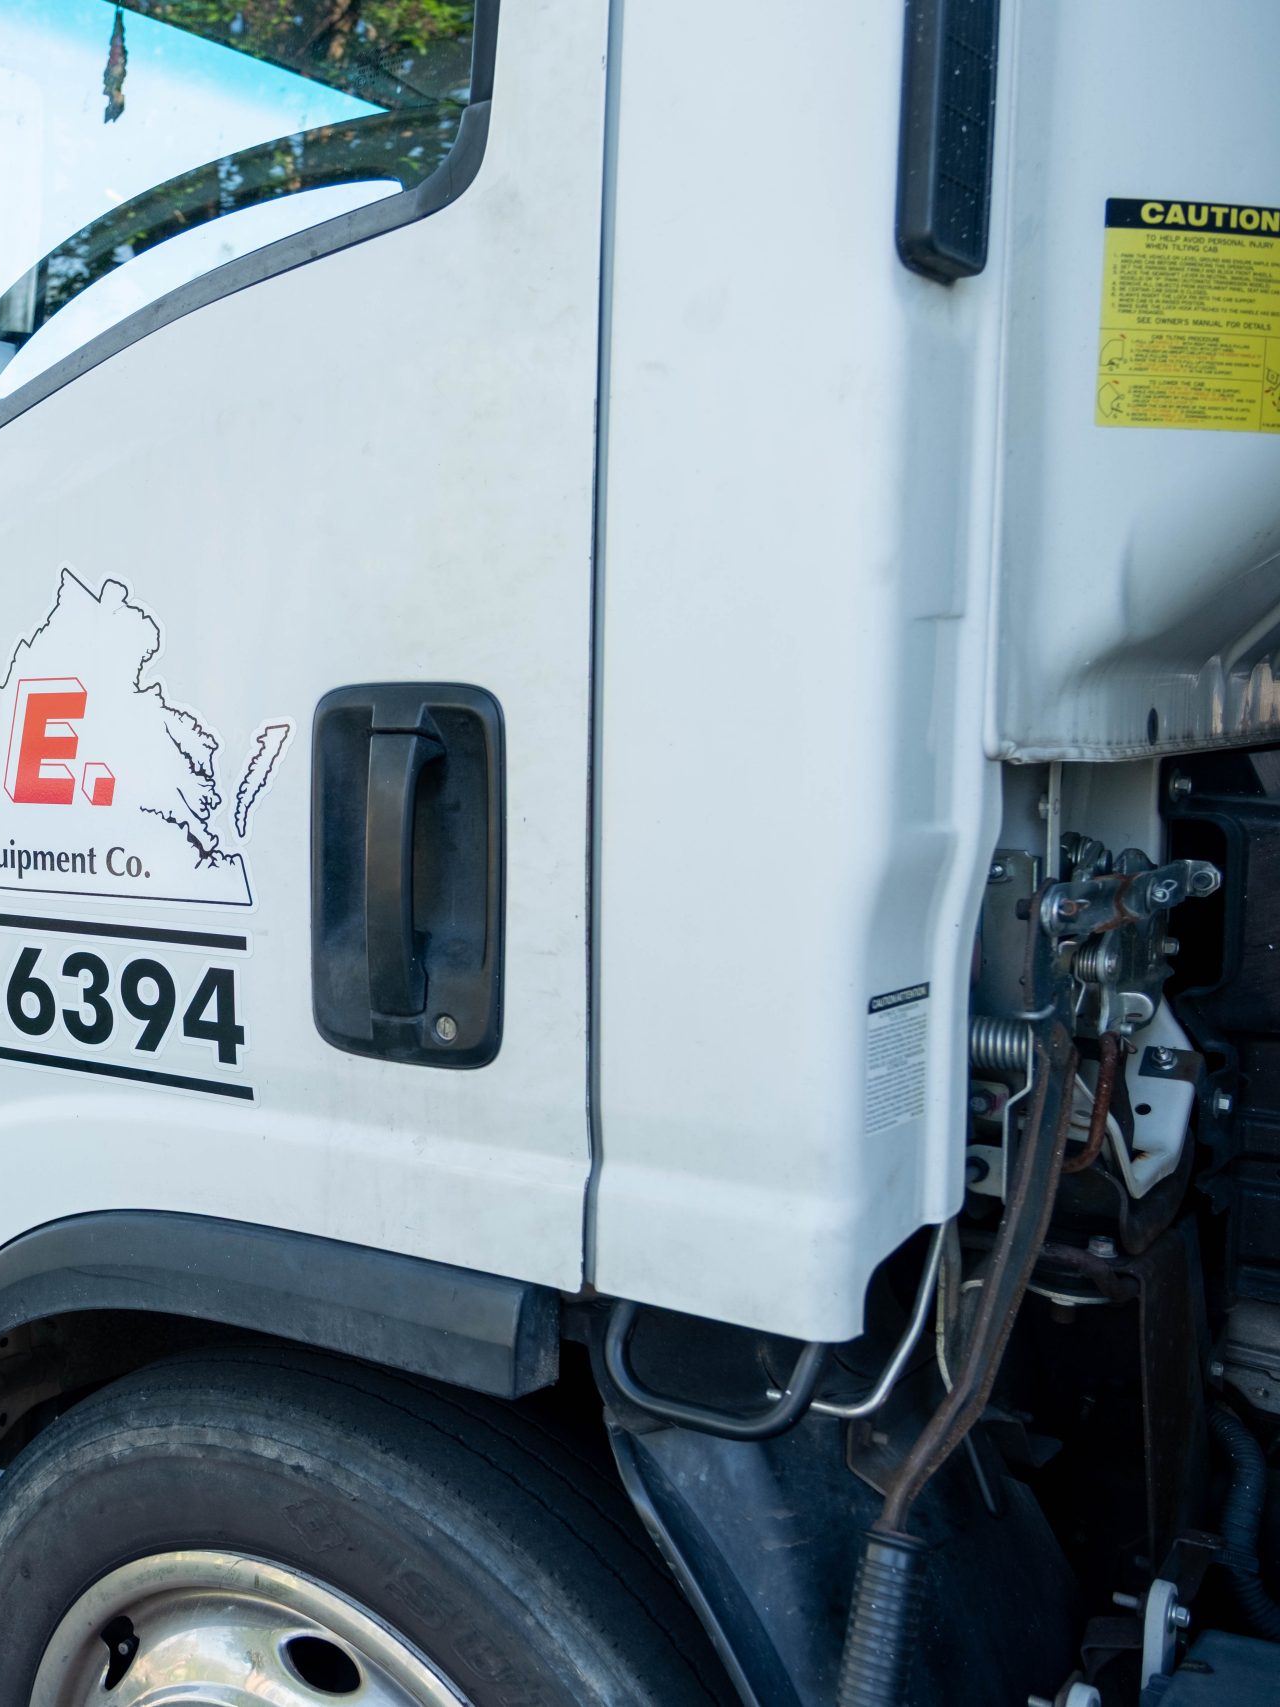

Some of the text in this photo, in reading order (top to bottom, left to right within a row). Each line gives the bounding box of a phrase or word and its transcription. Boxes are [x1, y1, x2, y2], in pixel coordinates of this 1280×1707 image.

[1140, 202, 1280, 232] CAUTION
[1145, 242, 1218, 254] WHEN TILTING CAB
[1160, 234, 1180, 242] HELP
[1183, 236, 1206, 244] AVOID
[1208, 237, 1246, 247] PERSONAL
[1248, 239, 1274, 249] INJURY
[1136, 316, 1152, 324] SEE
[1192, 319, 1223, 328] MANUAL
[1226, 321, 1241, 329] FOR
[1243, 322, 1271, 331] DETAILS
[106, 846, 151, 879] Co.
